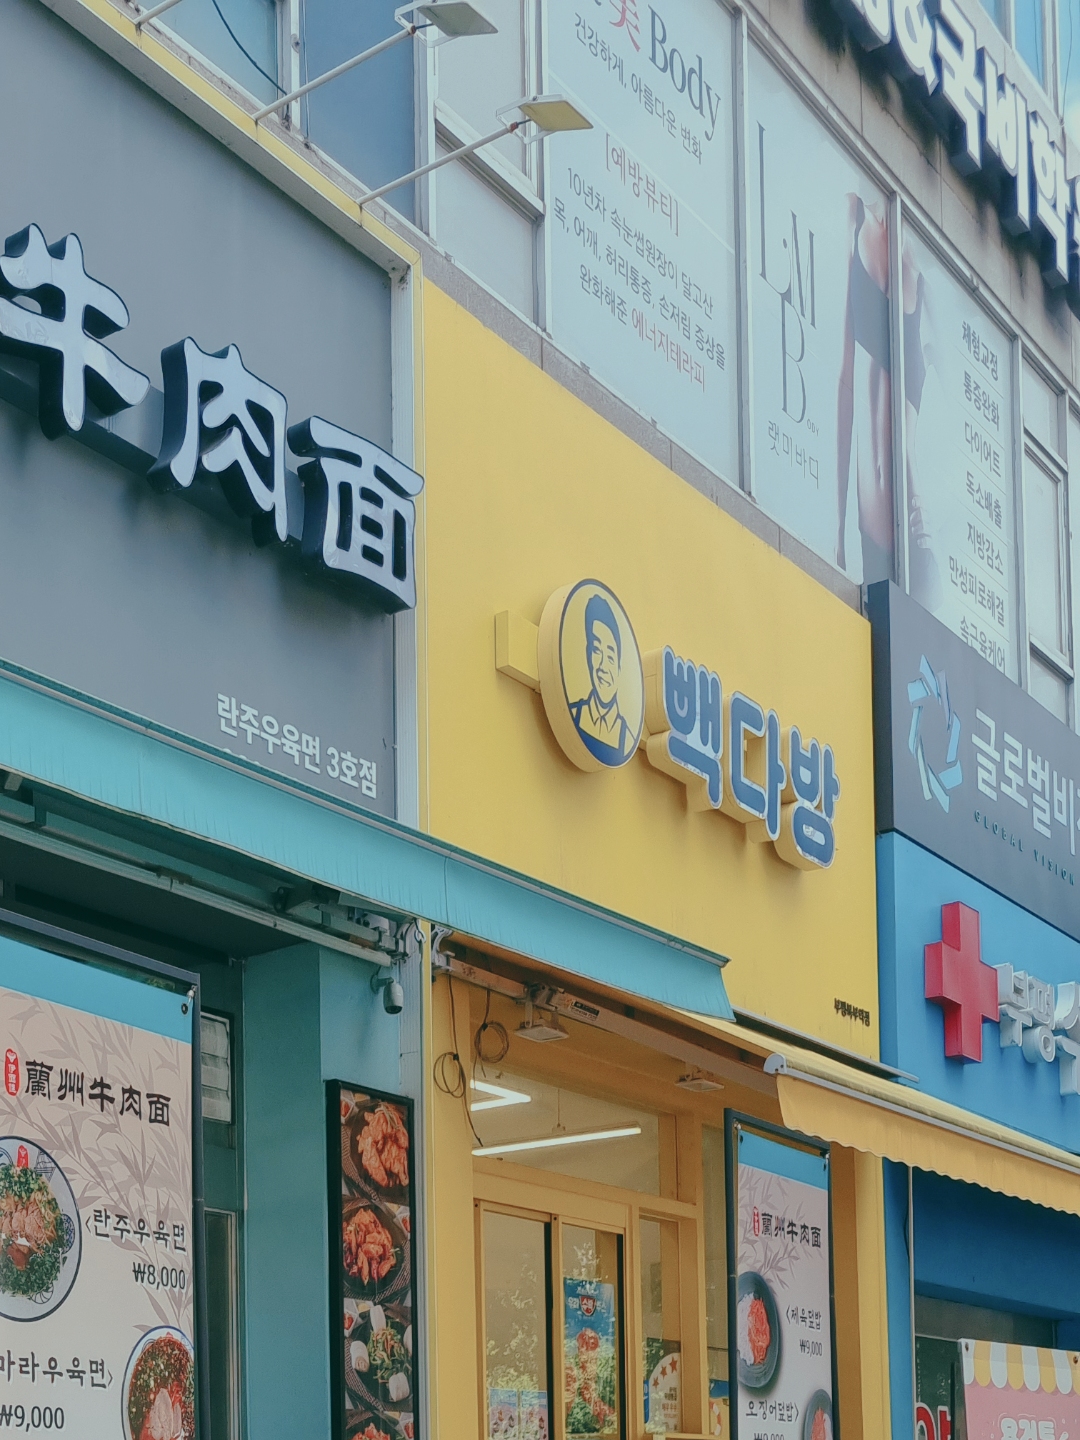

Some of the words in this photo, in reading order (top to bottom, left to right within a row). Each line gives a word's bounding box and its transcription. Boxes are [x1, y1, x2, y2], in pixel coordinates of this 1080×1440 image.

[647, 4, 721, 141] Body
[631, 73, 677, 138] 아름다운
[680, 122, 702, 165] 변화
[568, 168, 607, 222] 10년차
[610, 207, 678, 290] 속눈썹원장이
[579, 263, 628, 326] 완화해준
[631, 308, 706, 393] 에너지테라피
[658, 295, 691, 340] 손저림
[694, 324, 726, 370] 증상을
[963, 369, 1000, 432] 통증완화
[964, 420, 1002, 478] 다이어트
[966, 470, 1003, 531] 독소배출
[966, 520, 1004, 577] 지방감소
[948, 555, 1006, 628] 만성피로해결
[216, 692, 321, 775] 란주우육면
[325, 746, 377, 800] 3호점
[971, 707, 1080, 857] 글로벌비
[974, 809, 1025, 854] GLOBAL
[1034, 848, 1077, 887] VISION
[24, 1059, 171, 1127] 蘭州牛肉面
[91, 1208, 187, 1253] 란주우육면
[132, 1261, 186, 1291] ₩8,000
[799, 1338, 823, 1358] ₩9,000
[745, 1400, 794, 1423] 오징어덮밥
